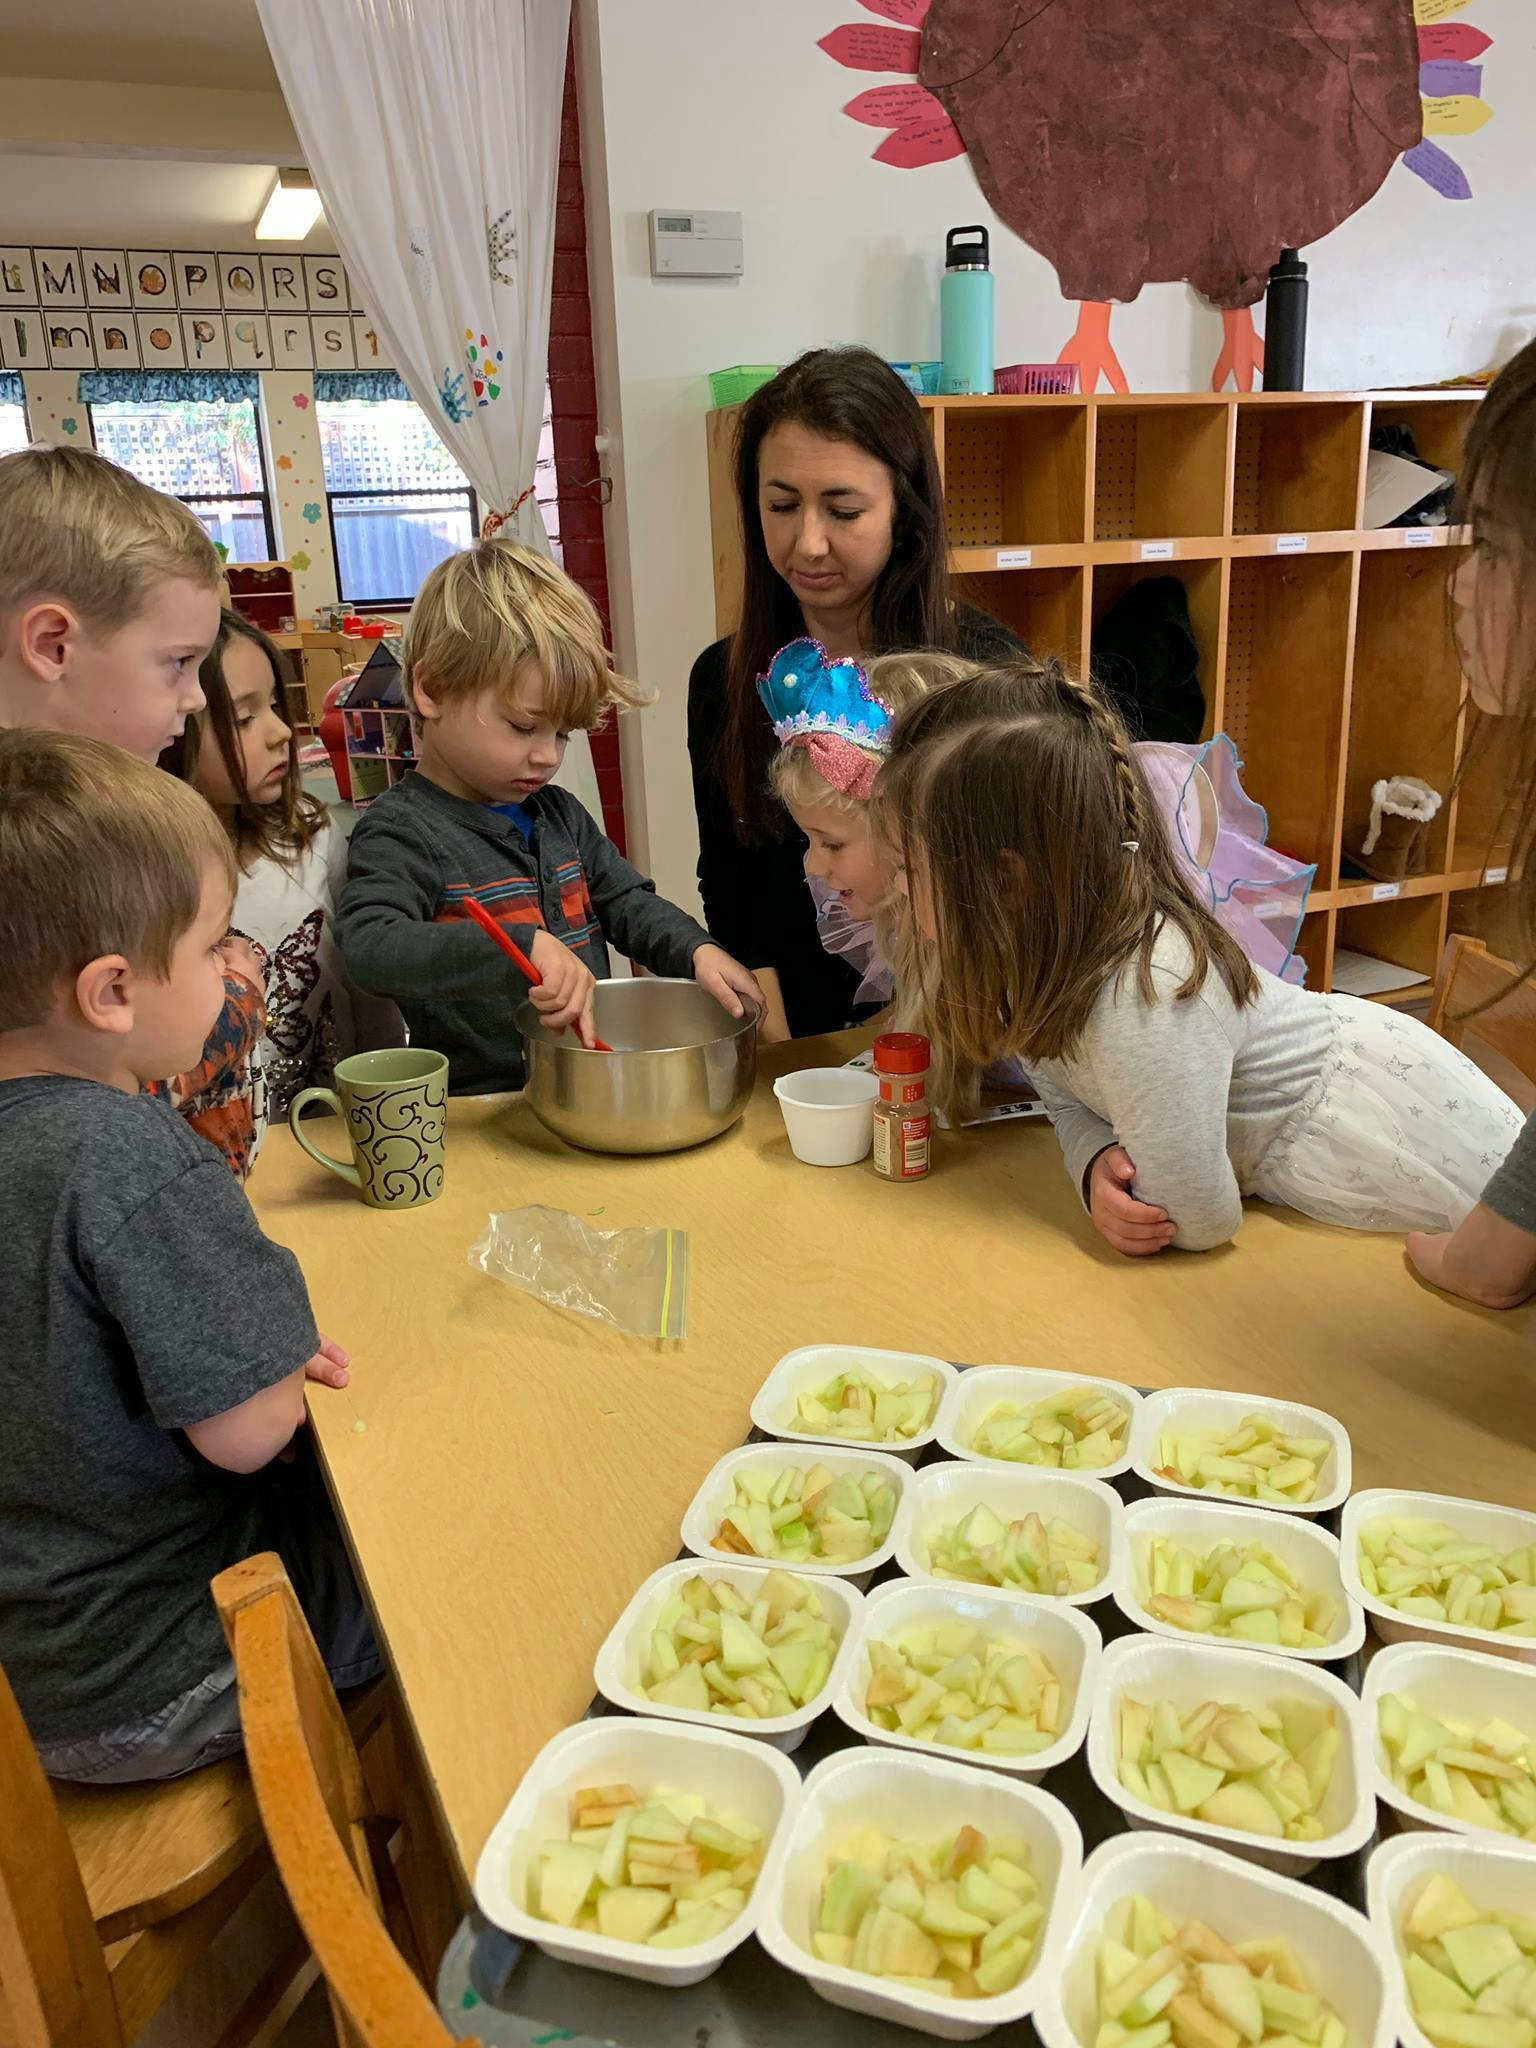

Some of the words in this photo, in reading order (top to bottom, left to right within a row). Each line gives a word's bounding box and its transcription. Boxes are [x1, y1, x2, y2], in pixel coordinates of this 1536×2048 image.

[1, 260, 26, 293] L
[42, 261, 76, 294] M
[93, 262, 121, 294] N
[139, 264, 167, 295] O
[184, 265, 207, 296] P
[272, 267, 297, 298] R
[316, 268, 338, 299] S
[50, 327, 89, 348] m
[103, 328, 128, 350] n
[150, 328, 172, 350] o
[193, 320, 215, 359] p
[284, 329, 297, 351] r
[324, 330, 342, 351] s
